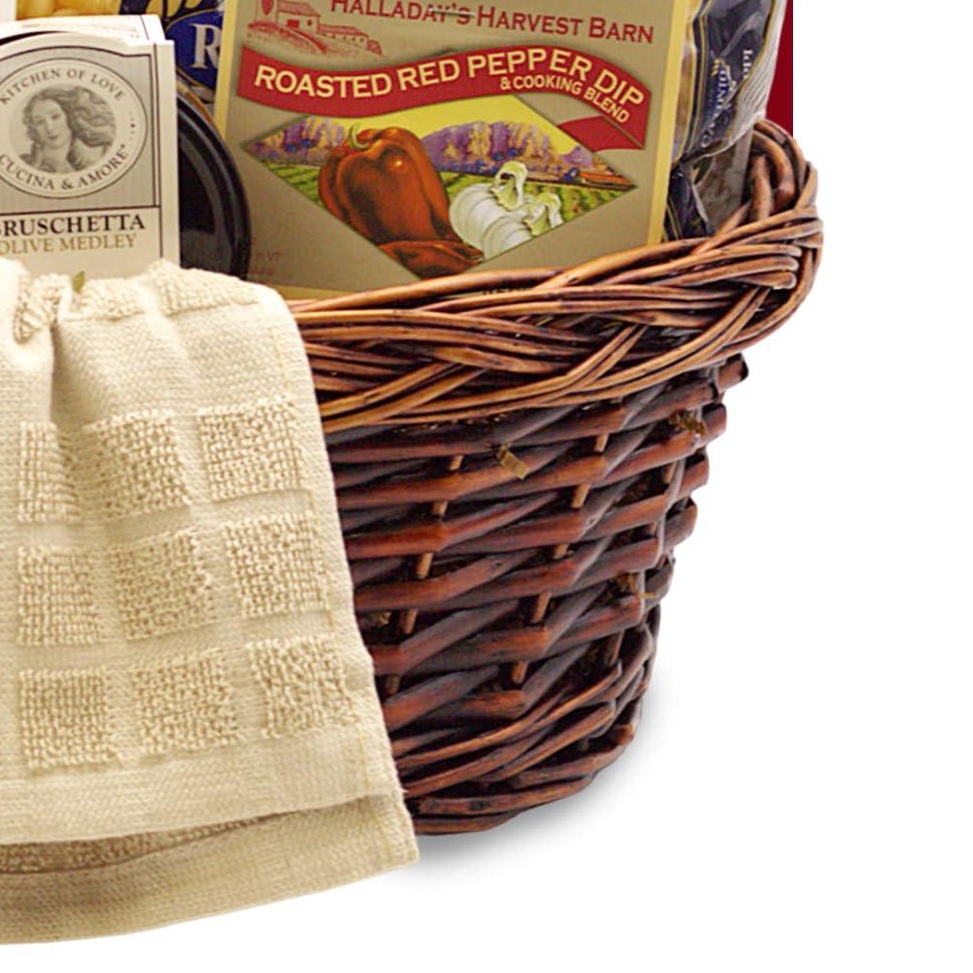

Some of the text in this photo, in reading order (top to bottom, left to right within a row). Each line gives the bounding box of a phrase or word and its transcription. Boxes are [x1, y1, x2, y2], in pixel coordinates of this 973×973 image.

[476, 4, 584, 38] HARVEST
[588, 16, 655, 45] BARN
[66, 68, 88, 80] OF
[90, 73, 126, 102] LOVE
[253, 48, 645, 106] ROASTED RED PEPPER DIP
[512, 74, 584, 95] COOKING
[583, 86, 631, 124] BLEND
[60, 179, 74, 191] &
[77, 151, 127, 188] AMORE
[59, 232, 138, 253] MEDLEY
